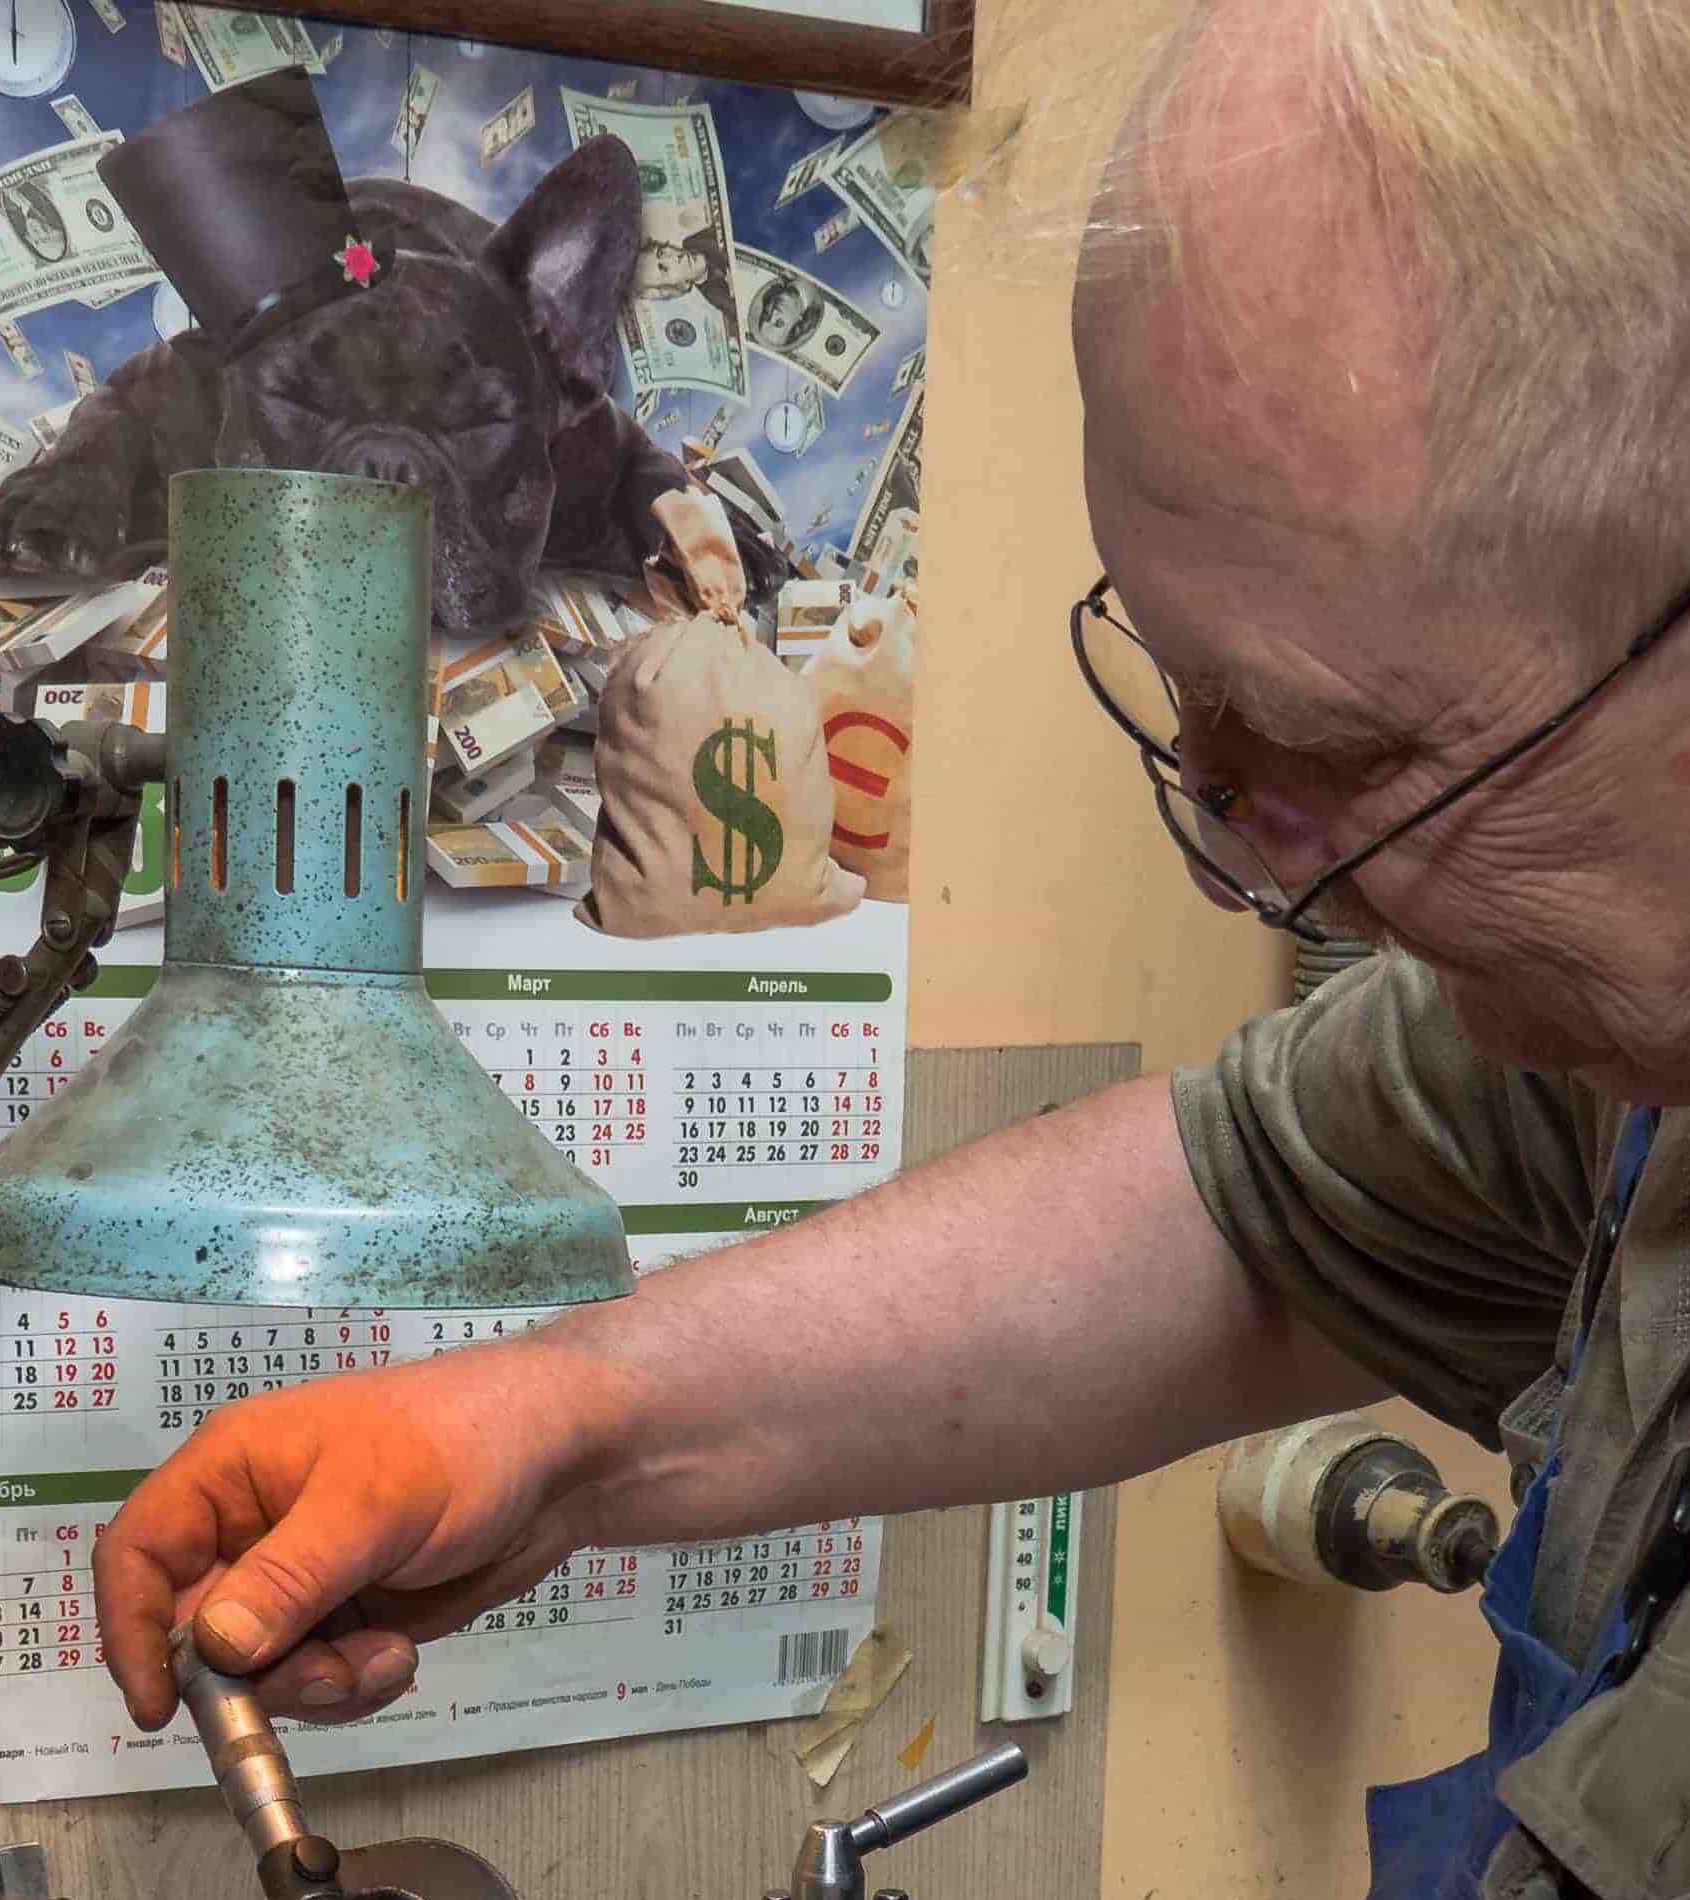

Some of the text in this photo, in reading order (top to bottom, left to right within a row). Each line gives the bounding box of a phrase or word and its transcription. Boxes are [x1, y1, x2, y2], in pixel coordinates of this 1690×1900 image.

[454, 725, 483, 761] 200
[507, 974, 552, 995] Март
[747, 976, 808, 996] Апрель
[44, 1020, 105, 1039] Сб Вс
[485, 1021, 642, 1041] Ср Чт Пт Сб Вс
[676, 1022, 880, 1041] Пн Вт Ср Чт Пт Сб Вс
[526, 1048, 641, 1066] 1 2 3 4
[870, 1047, 877, 1065] 1
[6, 1076, 30, 1096] 12
[524, 1073, 644, 1092] 8 9 10 11
[685, 1071, 878, 1090] 2 3 4 5 6 7 8
[519, 1098, 646, 1117] 15 16 17 18
[684, 1095, 882, 1114] 9 10 11 12 13 14 15
[555, 1122, 646, 1142] 23 24 25
[680, 1119, 881, 1139] 16 17 18 19 20 21 22
[591, 1148, 610, 1166] 31
[14, 1365, 38, 1385] 18
[55, 1363, 78, 1382] 19
[91, 1362, 115, 1381] 20
[13, 1391, 38, 1411] 25
[54, 1390, 78, 1409] 26
[92, 1388, 116, 1407] 27
[1018, 1502, 1035, 1515] 20
[1018, 1528, 1033, 1540] 30
[1016, 1553, 1033, 1565] 40
[670, 1557, 861, 1590] 17 18 19 20 21 22 23
[1015, 1578, 1031, 1591] 50
[19, 1602, 42, 1620] 14
[58, 1599, 80, 1617] 15
[616, 1681, 627, 1701] 9
[448, 1701, 458, 1722] 1
[111, 1735, 121, 1755] 7
